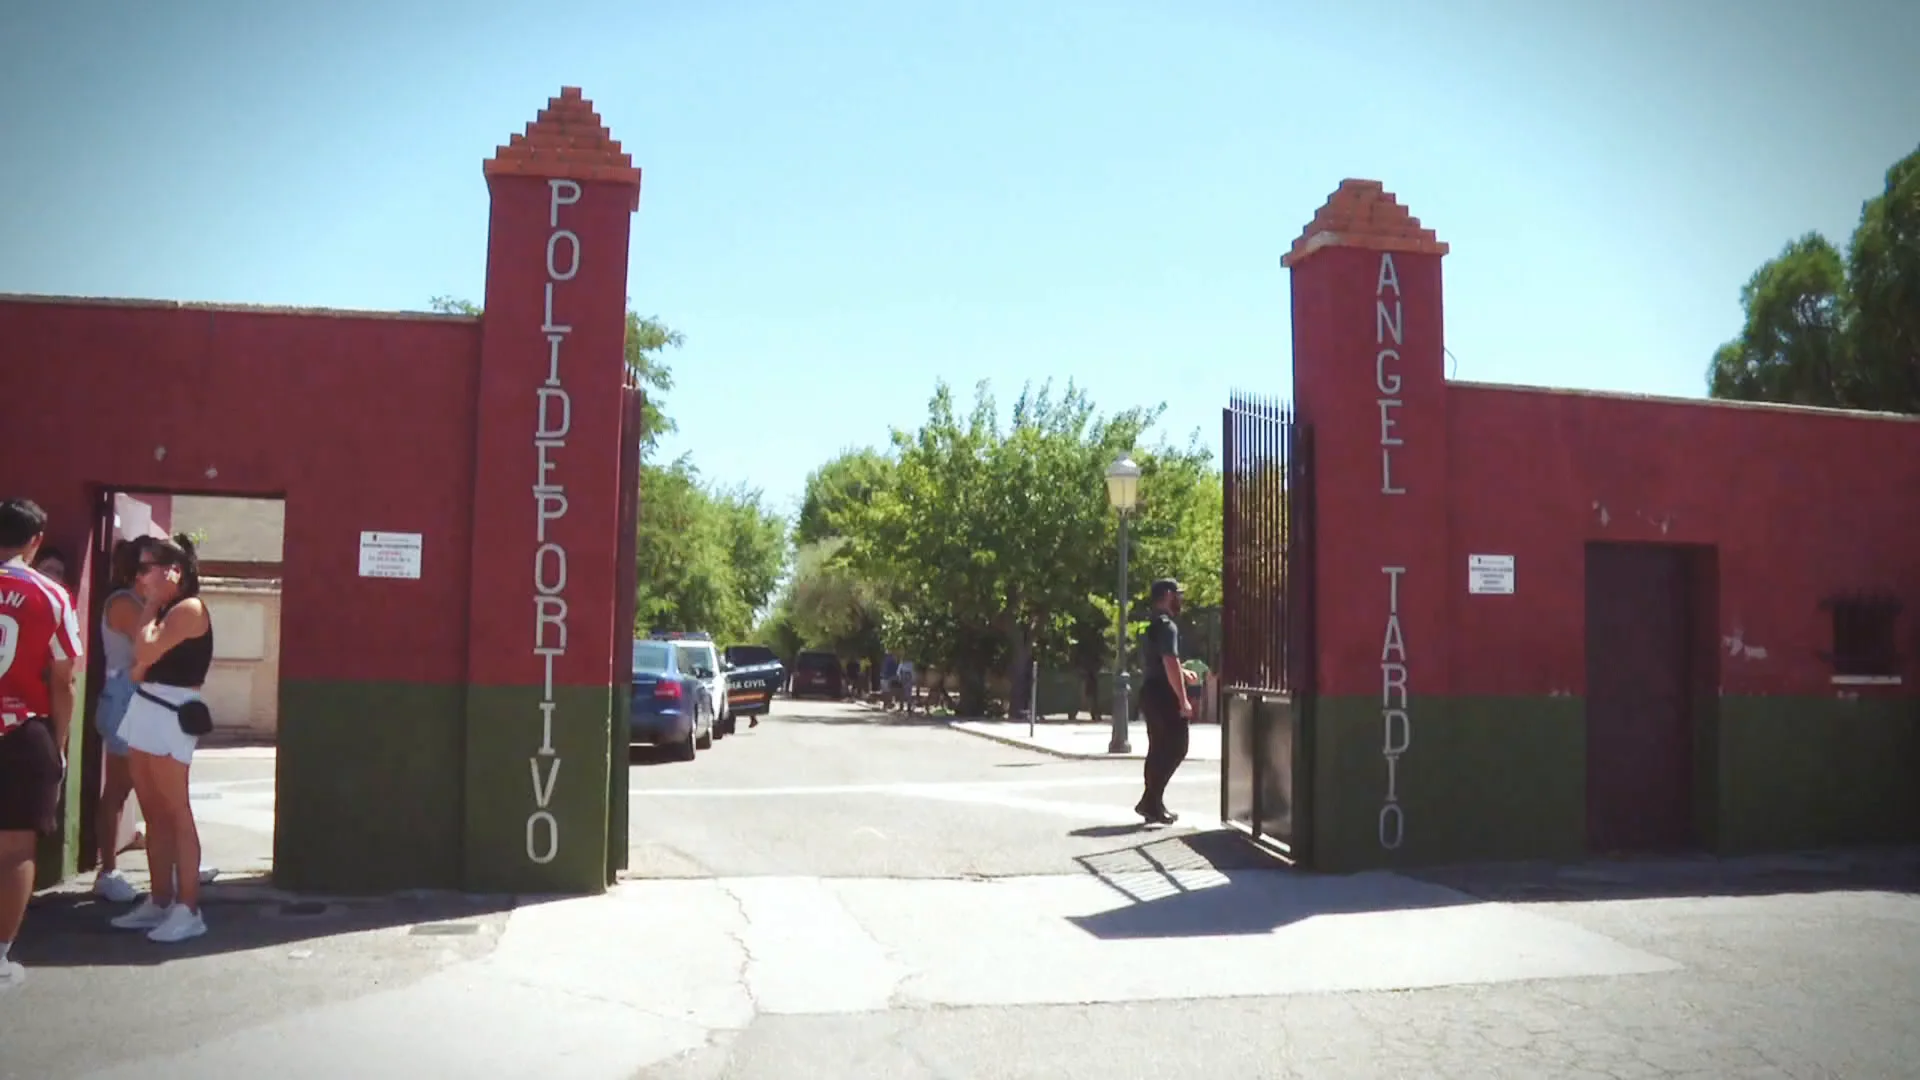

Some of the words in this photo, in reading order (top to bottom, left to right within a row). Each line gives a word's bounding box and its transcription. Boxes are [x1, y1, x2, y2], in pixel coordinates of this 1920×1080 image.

[1375, 252, 1406, 495] ANGEL
[525, 178, 583, 866] POLIDEPORTIVO
[743, 679, 767, 689] CIVIL
[1378, 566, 1411, 850] TARDIO
